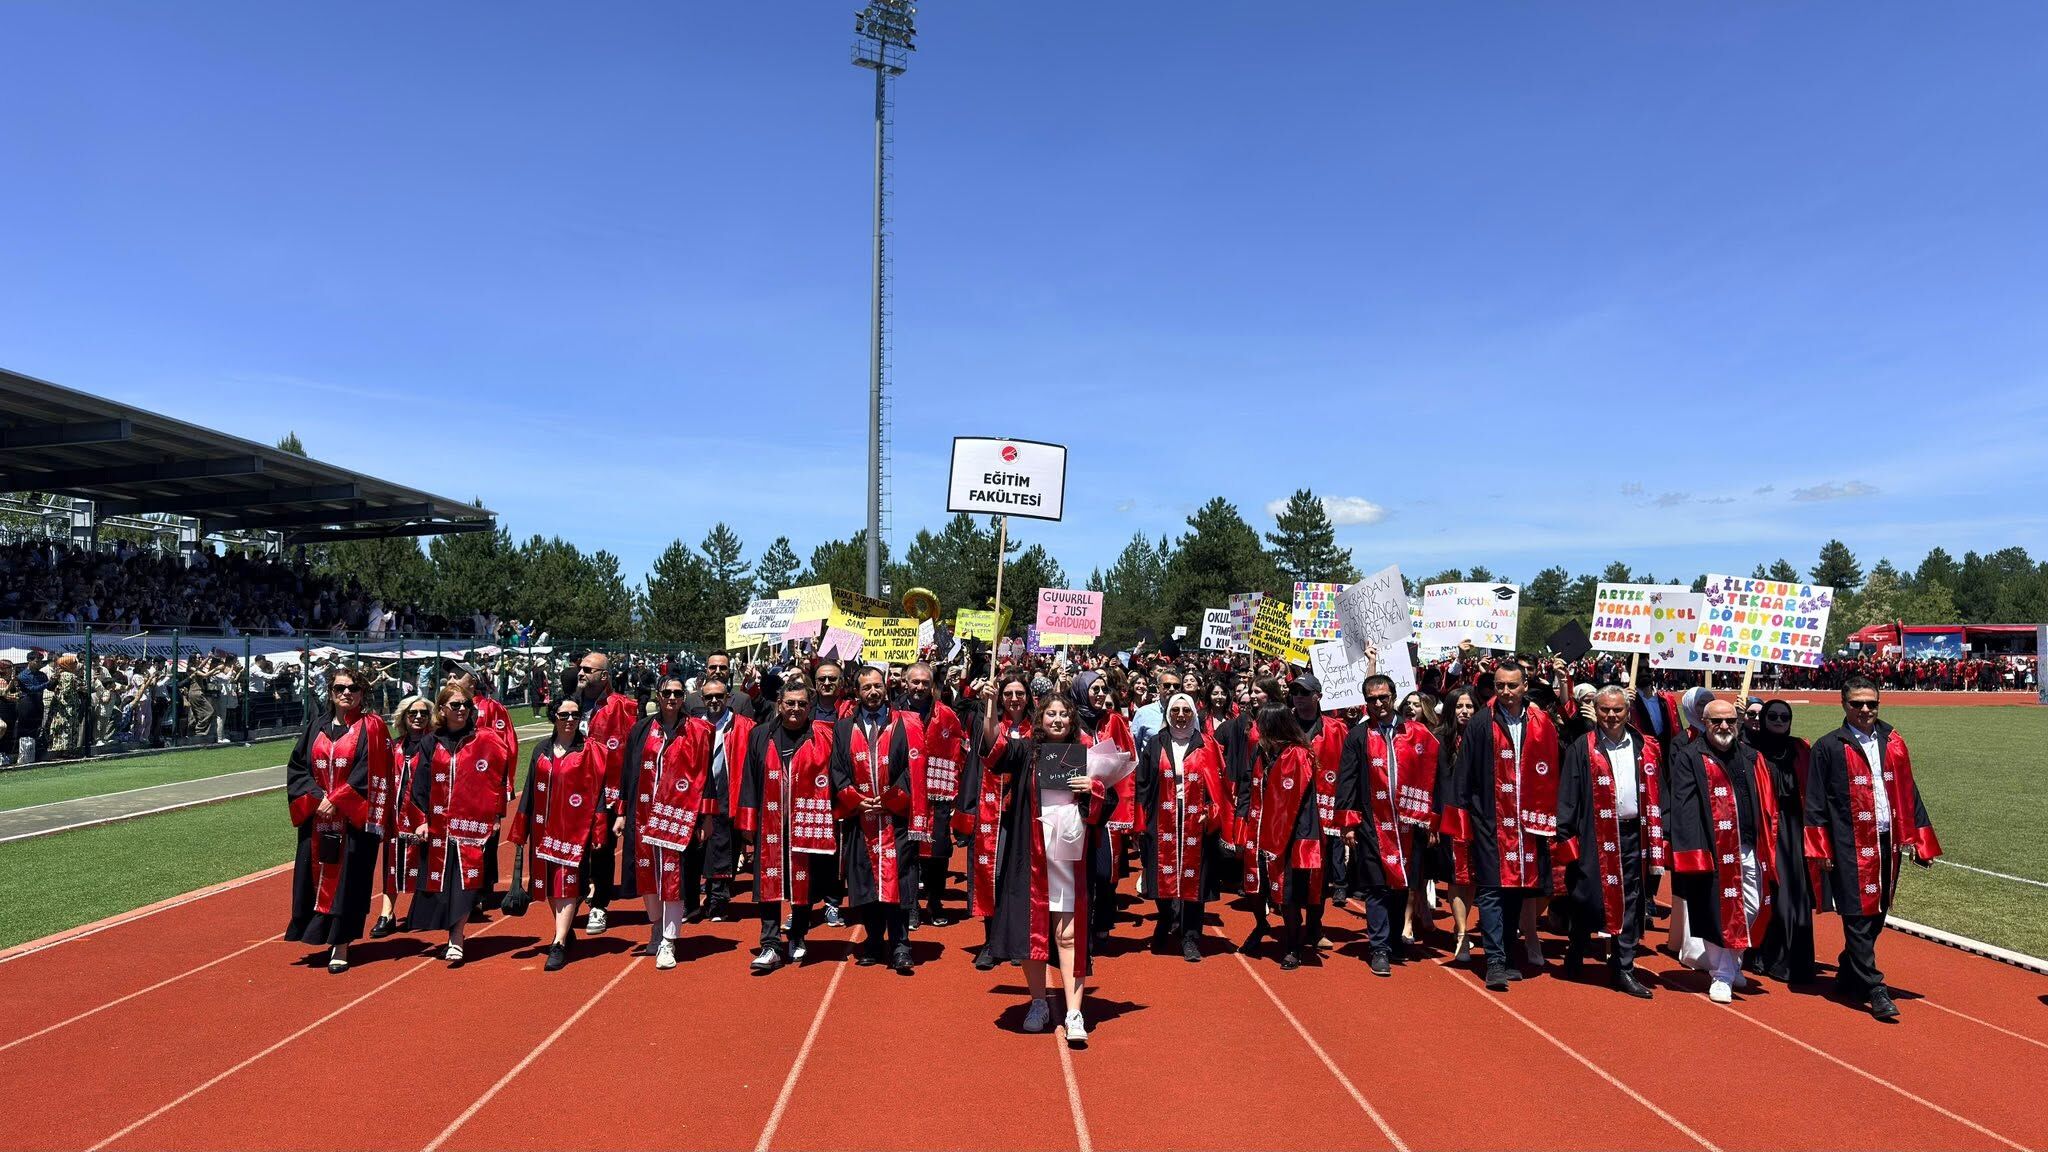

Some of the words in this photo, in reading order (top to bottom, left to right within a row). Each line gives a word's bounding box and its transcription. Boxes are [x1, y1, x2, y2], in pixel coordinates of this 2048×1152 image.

[983, 471, 1030, 488] EĞİTİM
[969, 489, 1042, 507] FAKÜLTESİ
[1723, 576, 1812, 598] İLKOKULA
[1043, 591, 1094, 605] GUUURRLL
[1599, 589, 1645, 601] ARTIK
[1727, 592, 1797, 611] TEKRAR
[1052, 605, 1058, 614] I
[1064, 605, 1088, 617] JUST
[1492, 608, 1517, 618] AMA
[1653, 607, 1696, 620] OKUL
[1709, 605, 1819, 630] DÖNÜYORUZ
[1046, 616, 1096, 630] GRADUADO
[1256, 613, 1292, 631] SAYMAYAC
[1595, 616, 1632, 629] ALMA
[1209, 625, 1232, 636] TAMA
[1698, 622, 1734, 639] AMA
[1739, 628, 1763, 641] BU
[1769, 631, 1822, 648] SEFER
[1485, 633, 1512, 645] XXL
[1703, 638, 1825, 666] BAŞROLDEYİZ
